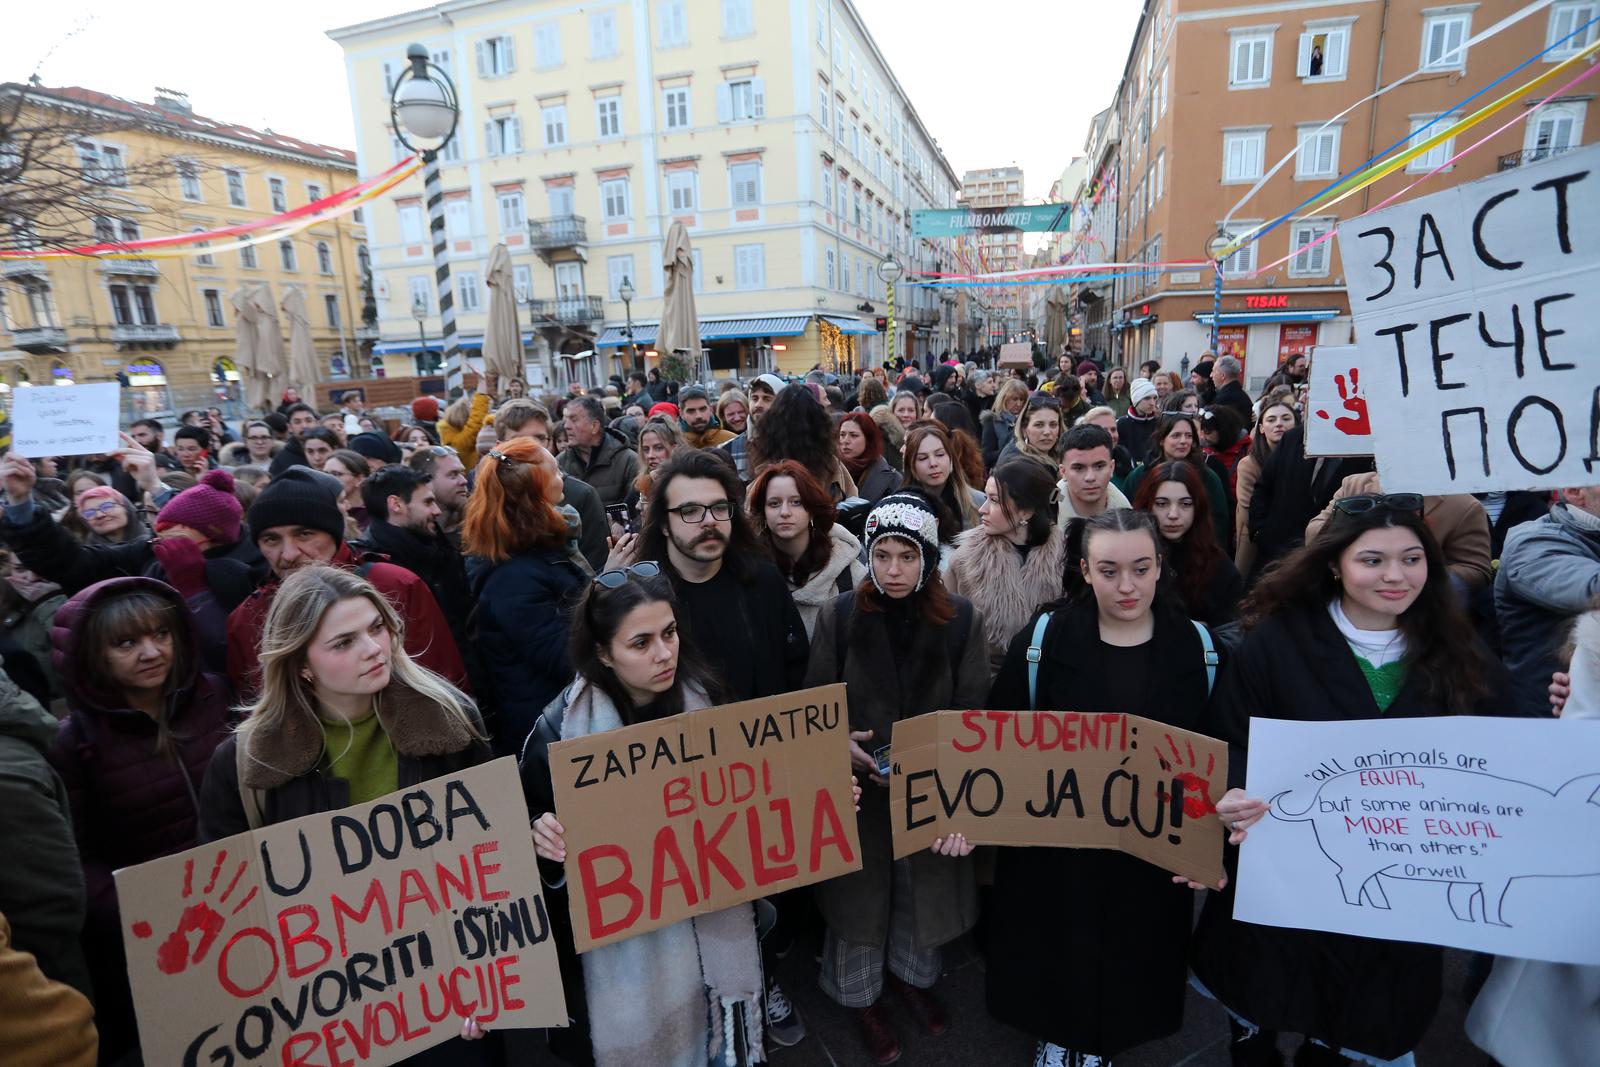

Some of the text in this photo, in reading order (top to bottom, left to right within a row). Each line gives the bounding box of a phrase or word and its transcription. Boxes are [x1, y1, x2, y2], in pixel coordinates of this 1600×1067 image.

[950, 213, 981, 228] FIUME
[982, 215, 990, 226] O
[990, 212, 1031, 226] MORTE!
[1246, 295, 1288, 308] TISAK
[1375, 293, 1577, 397] ТЕЧЕ
[570, 702, 839, 789] ZAPALI VATRU
[952, 709, 1138, 753] STUDENTI:
[1354, 748, 1448, 768] animals
[1457, 753, 1487, 771] are
[1360, 770, 1425, 789] EQUAL,
[663, 758, 772, 818] BUDI
[1026, 768, 1084, 818] JA
[1318, 796, 1524, 817] but some animals are
[261, 780, 491, 896] U DOBA
[1344, 815, 1503, 838] MORE EQUAL
[1368, 838, 1412, 854] than
[578, 788, 855, 940] BAKLJA
[1404, 863, 1467, 879] Orwell
[217, 841, 509, 998] OBMANE
[183, 930, 434, 1067] GOVORITI
[282, 955, 525, 1067] REVOLUCIJE
